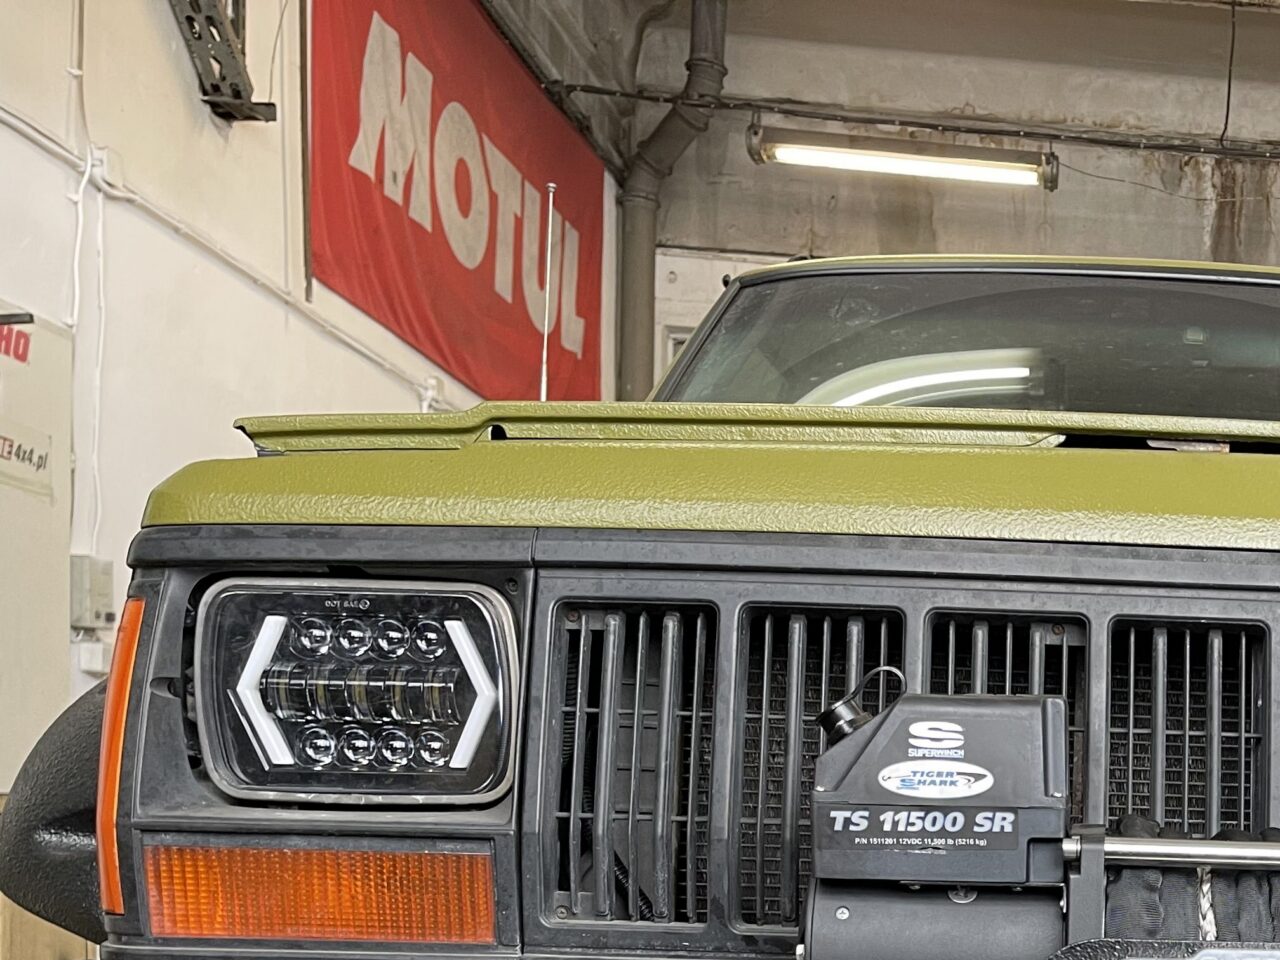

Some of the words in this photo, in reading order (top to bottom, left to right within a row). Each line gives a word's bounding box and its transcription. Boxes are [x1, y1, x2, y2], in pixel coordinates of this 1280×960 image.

[348, 10, 585, 360] MOTUL
[908, 748, 965, 758] SUPERWINCH
[911, 770, 956, 778] TIGER
[900, 778, 959, 787] SHARK
[830, 811, 870, 831] TS
[879, 811, 966, 832] 11500
[973, 812, 1016, 832] SR
